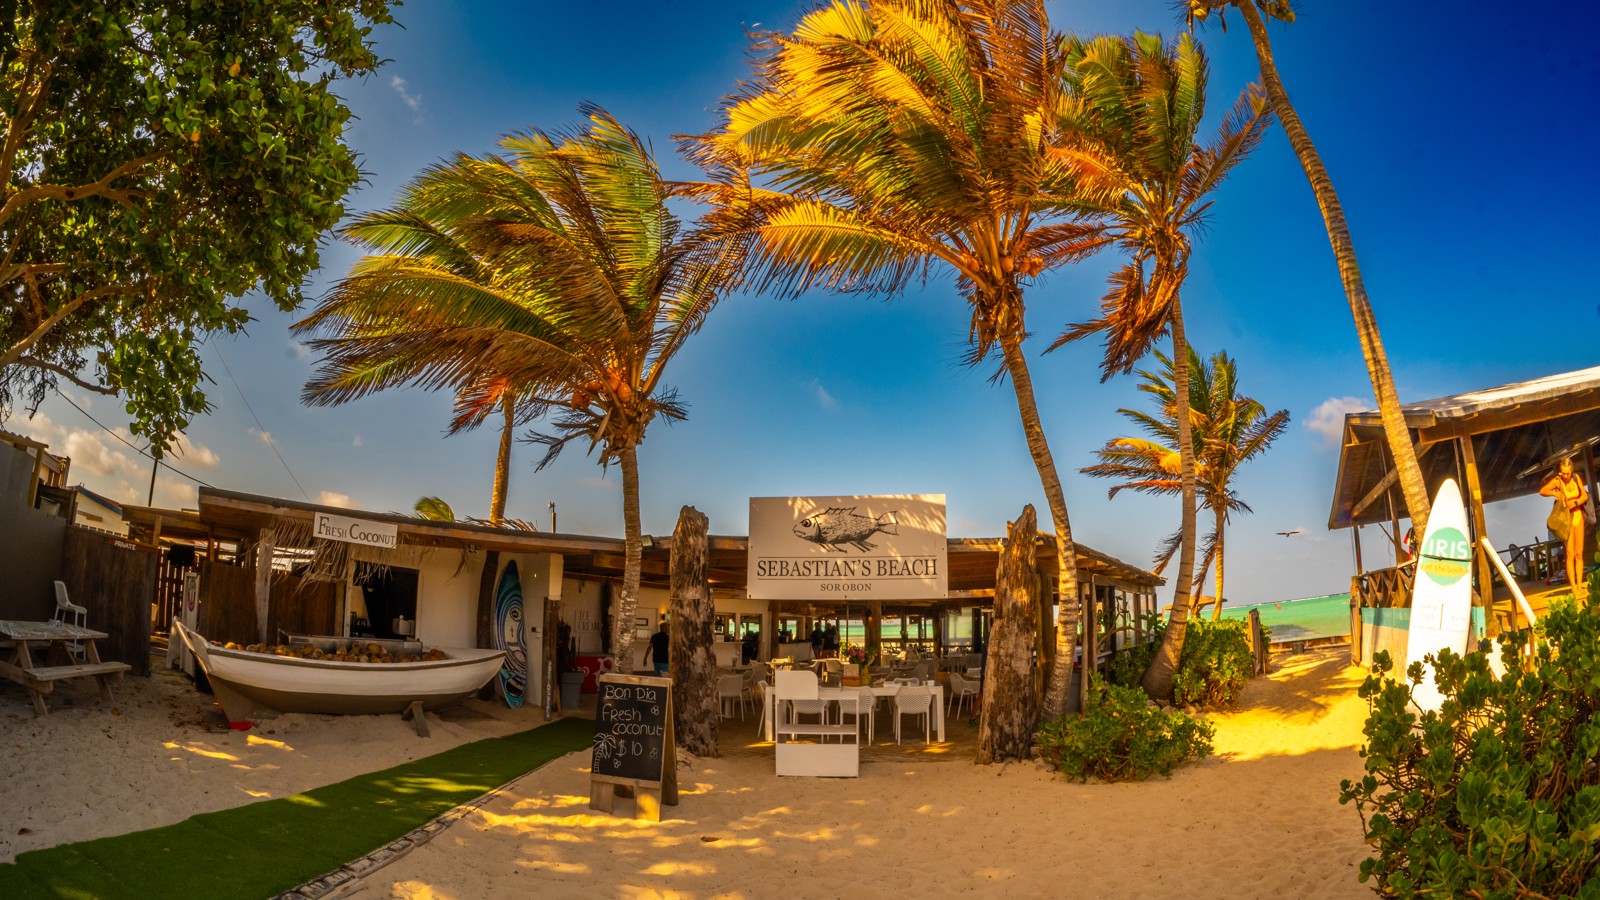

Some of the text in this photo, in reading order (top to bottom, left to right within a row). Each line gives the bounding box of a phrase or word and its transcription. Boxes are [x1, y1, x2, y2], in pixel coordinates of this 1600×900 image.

[317, 515, 396, 545] FRESH COCONUT
[114, 540, 136, 551] PRIVATE
[1428, 538, 1468, 560] IRIS
[756, 558, 938, 577] SEBASTIAN'S BEACH
[820, 583, 872, 592] SOROBON
[635, 687, 657, 700] Dia
[611, 722, 663, 736] coconut
